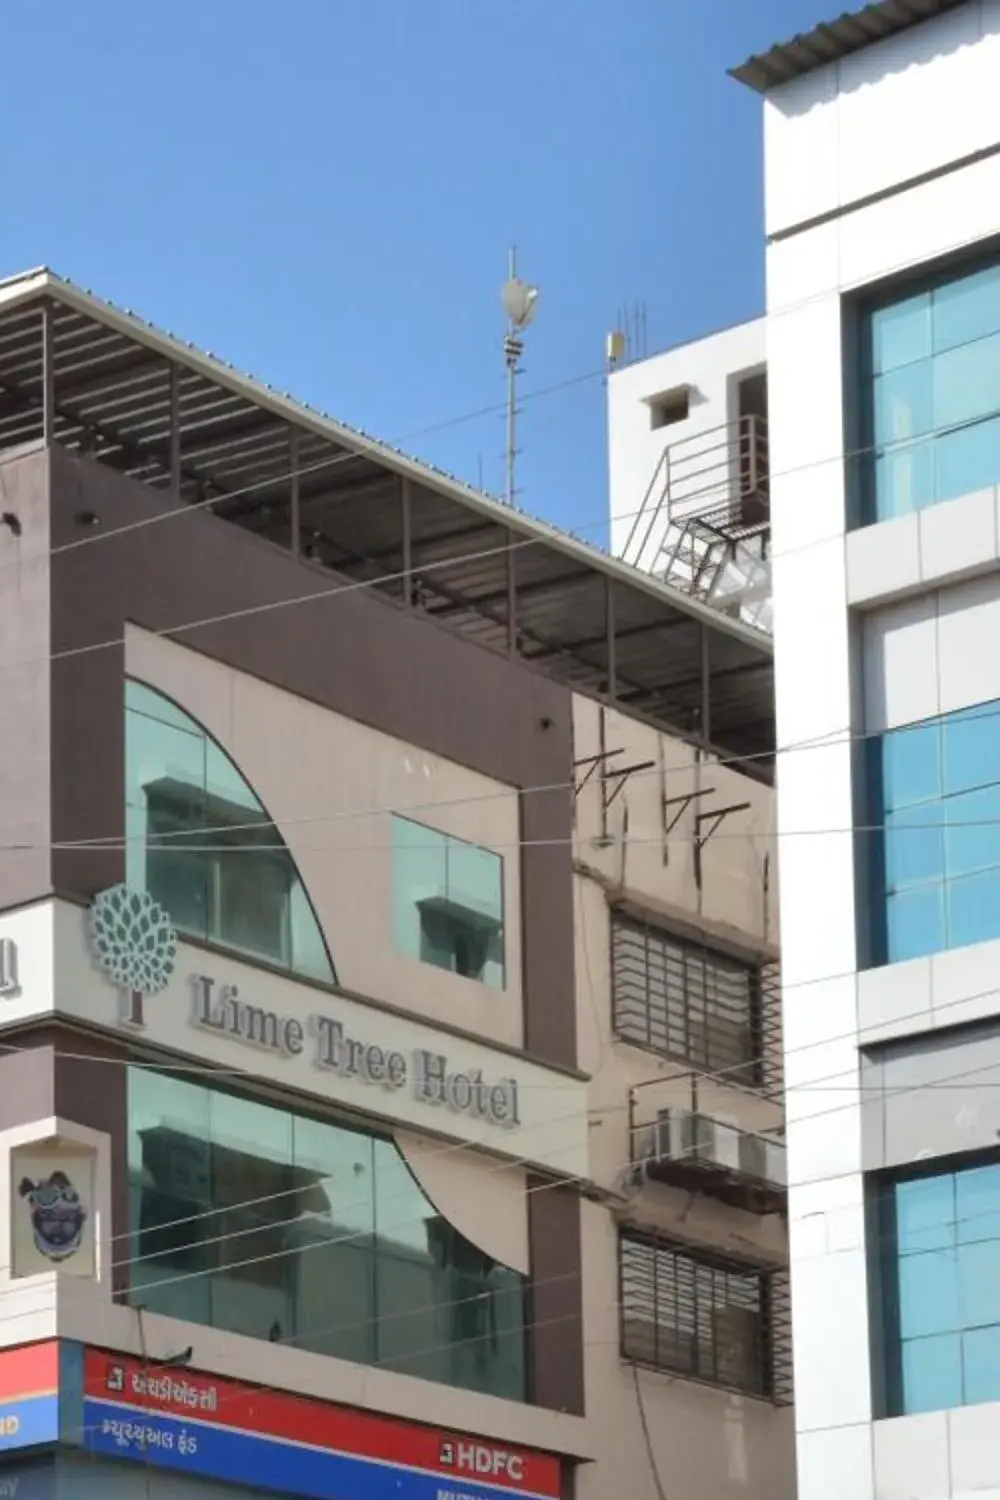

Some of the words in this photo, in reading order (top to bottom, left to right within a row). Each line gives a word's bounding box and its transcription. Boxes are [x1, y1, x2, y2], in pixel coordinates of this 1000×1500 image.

[194, 976, 305, 1055] Lime
[315, 1016, 407, 1090] Tree
[417, 1048, 523, 1127] Hotel
[456, 1441, 524, 1481] HDFC
